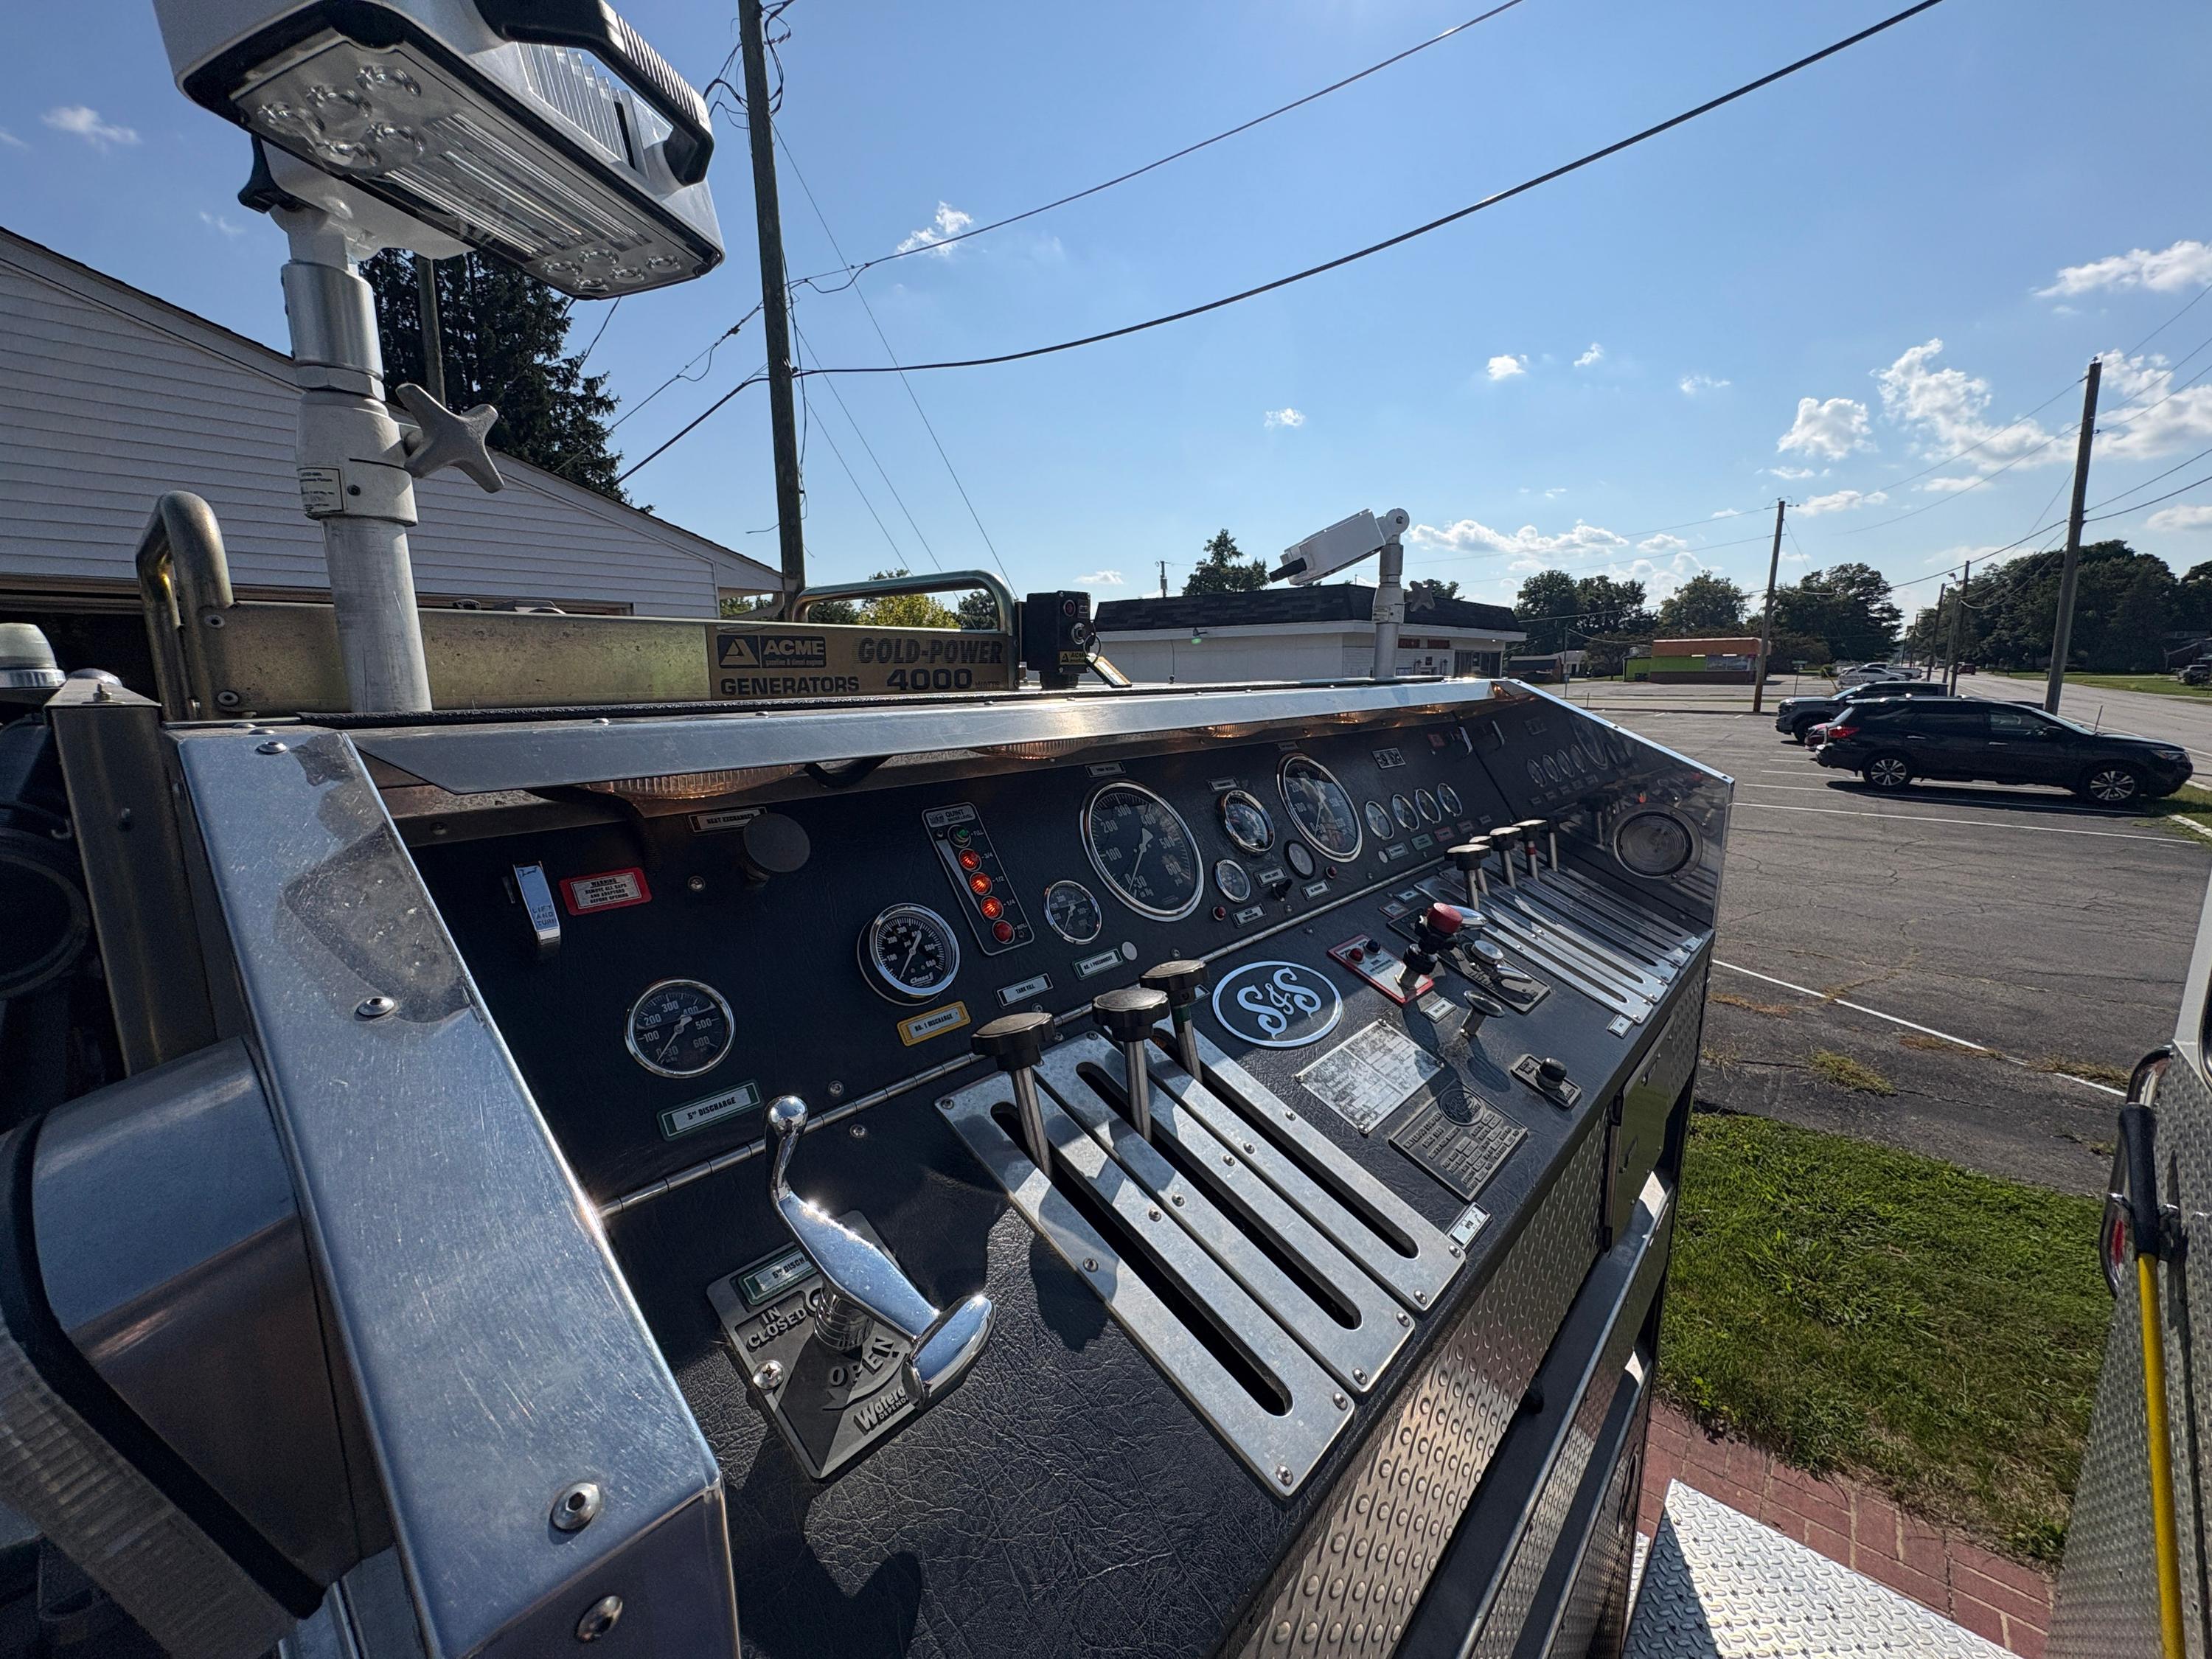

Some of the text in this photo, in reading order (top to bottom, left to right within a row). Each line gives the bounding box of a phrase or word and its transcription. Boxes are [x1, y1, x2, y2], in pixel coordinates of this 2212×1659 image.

[763, 639, 824, 655] ACME
[856, 637, 1003, 664] GOLD-POWER
[720, 676, 859, 695] GENERATORS
[887, 668, 973, 691] 4000
[945, 809, 964, 817] QUINT
[1114, 804, 1132, 817] 300
[1100, 819, 1119, 834] 200
[1140, 813, 1156, 827] 400
[1158, 836, 1175, 849] 500
[1106, 846, 1122, 861] 100
[1165, 861, 1181, 876] 600
[591, 877, 616, 886] WARNING
[532, 905, 552, 914] LIFT
[536, 911, 553, 919] AND
[661, 1000, 679, 1013] 300
[683, 1006, 699, 1015] 400
[1237, 967, 1322, 1040] S&S
[644, 1013, 662, 1026] 200
[695, 1018, 712, 1030] 500
[928, 1013, 953, 1026] DISCHARGE
[643, 1030, 660, 1043] 100
[693, 1035, 710, 1048] 600
[698, 1096, 737, 1117] DISCHARGE
[783, 1256, 808, 1273] DISCH
[760, 1306, 782, 1324] IN
[748, 1308, 807, 1348] CLOSED
[830, 1335, 895, 1387] OPEN
[855, 1385, 906, 1433] Watero
[878, 1394, 910, 1420] DEPEND
